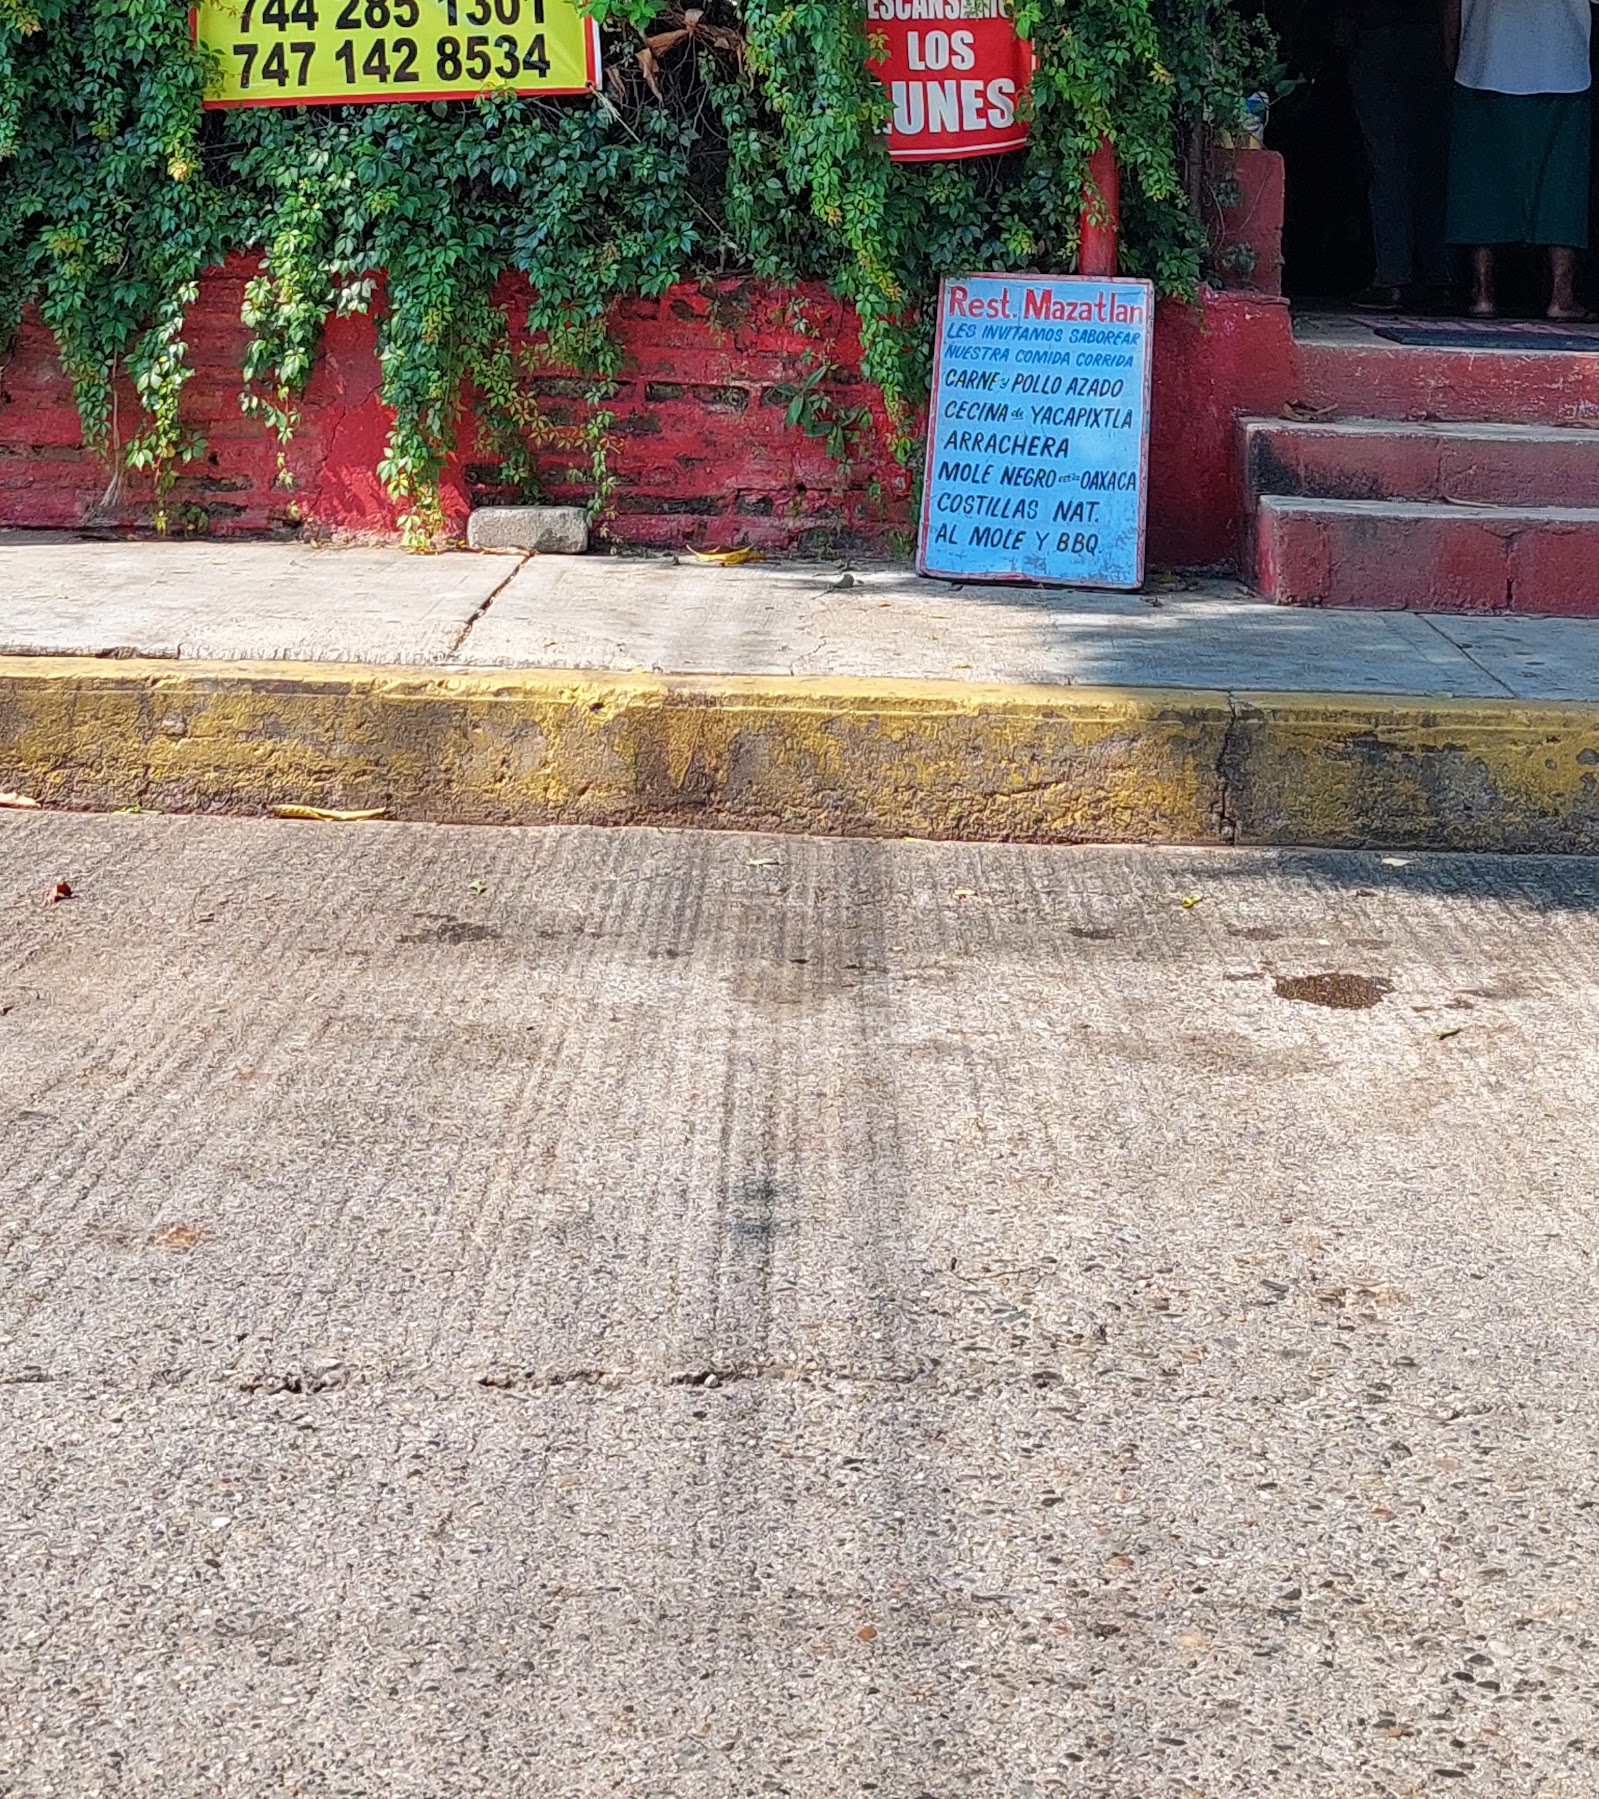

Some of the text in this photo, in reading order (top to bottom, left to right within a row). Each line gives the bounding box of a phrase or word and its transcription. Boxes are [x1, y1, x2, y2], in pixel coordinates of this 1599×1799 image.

[232, 33, 551, 89] 747 142 8534
[906, 29, 976, 72] LOS
[871, 78, 1017, 136] UNES
[949, 285, 1144, 325] Rest. Mazatlan
[946, 322, 1141, 346] LES INVITAMOS SABOREAR
[944, 344, 1134, 368] NUESTRA COMIDA CORRIDA
[945, 368, 1000, 391] CARNE
[1011, 373, 1062, 395] POLLO
[1065, 377, 1124, 398] AZADO
[944, 400, 1009, 423] CECINA
[1030, 405, 1134, 429] YACAPIXTLA
[943, 429, 1070, 458] ARRACHERA
[938, 460, 994, 485] MOLE
[1000, 465, 1057, 488] NEGRO
[1080, 470, 1137, 492] OAXACA
[937, 491, 1100, 523] COSTILLAS NAT.
[935, 523, 959, 545] AL
[968, 525, 1027, 550] MOLE
[1035, 531, 1050, 551] Y
